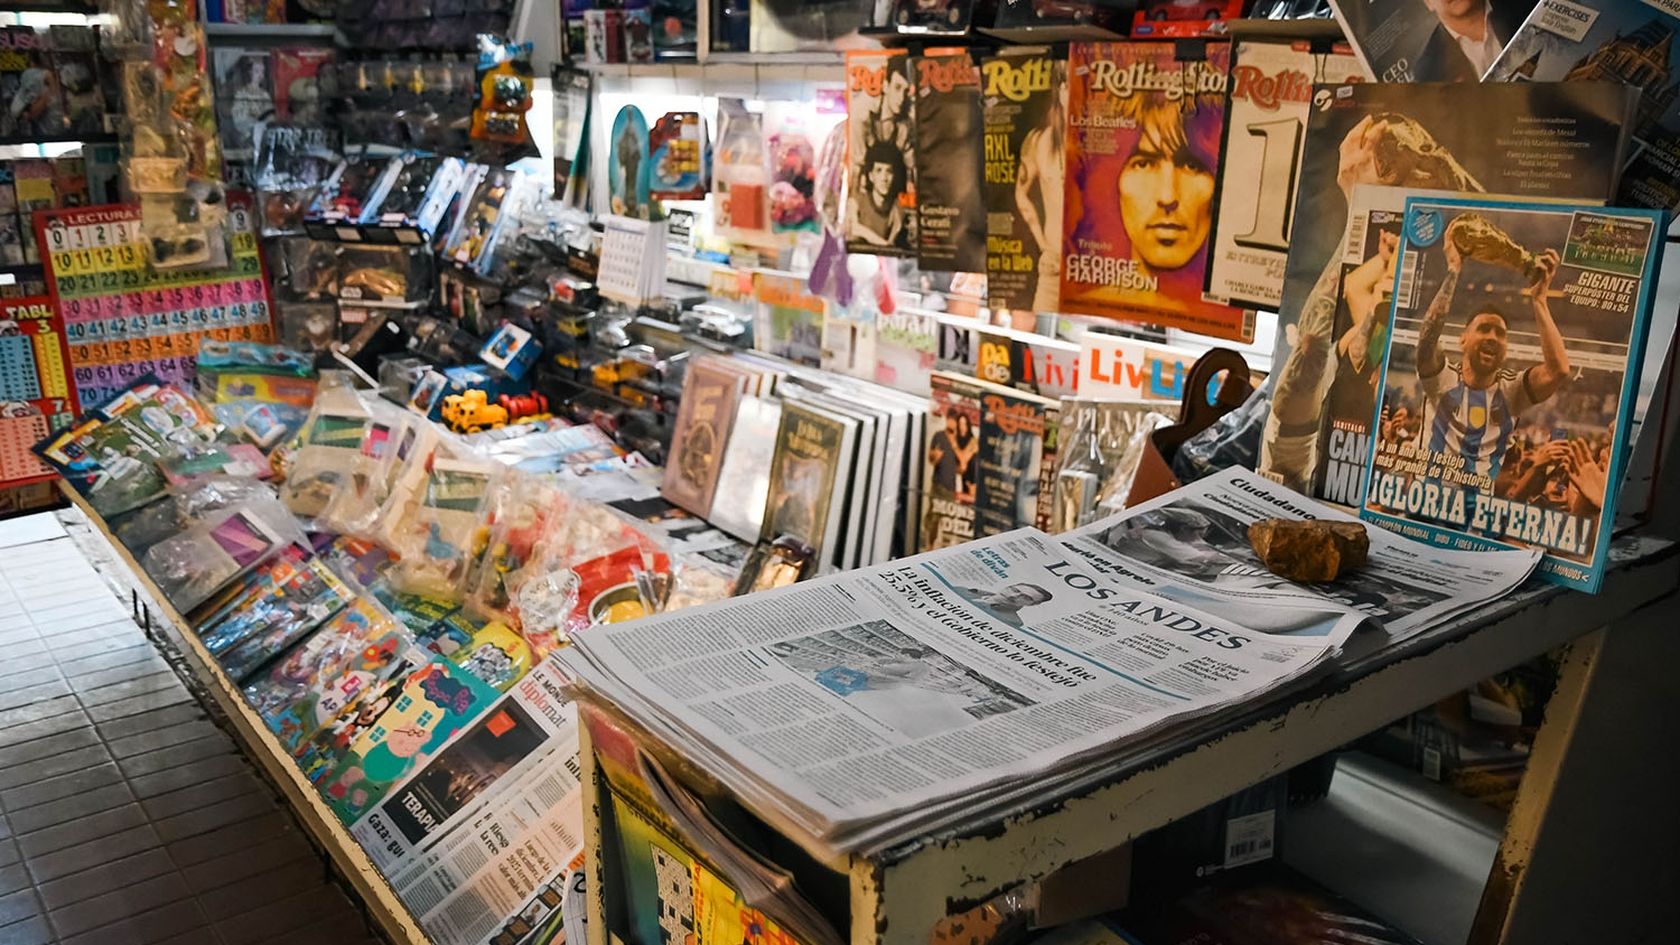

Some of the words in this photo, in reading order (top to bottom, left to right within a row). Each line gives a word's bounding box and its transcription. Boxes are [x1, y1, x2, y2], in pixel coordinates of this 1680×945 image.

[1383, 58, 1408, 84] CEO
[1094, 116, 1137, 129] Beatles
[985, 134, 1014, 161] AXL
[985, 162, 1016, 184] ROSE
[68, 210, 133, 224] LECTURA
[53, 230, 62, 244] 0
[75, 229, 83, 241] 1
[95, 226, 105, 240] 2
[118, 224, 126, 237] 3
[55, 254, 71, 268] 10
[75, 253, 91, 266] 11
[96, 250, 113, 264] 12
[118, 246, 134, 262] 13
[1066, 254, 1139, 272] GEORGE
[58, 277, 76, 291] 20
[81, 275, 96, 289] 21
[101, 272, 117, 286] 22
[122, 270, 139, 284] 23
[1066, 268, 1159, 292] HARRISON
[1578, 272, 1637, 294] GIGANTE
[1616, 293, 1630, 303] DEL
[69, 323, 84, 337] 40
[90, 321, 105, 335] 41
[112, 319, 126, 333] 42
[133, 316, 148, 330] 43
[153, 313, 168, 327] 44
[173, 312, 188, 325] 45
[192, 309, 208, 322] 46
[211, 307, 225, 319] 47
[232, 304, 247, 318] 48
[251, 302, 266, 316] 49
[73, 346, 88, 359] 50
[94, 344, 109, 357] 51
[76, 367, 93, 381] 60
[97, 366, 113, 380] 61
[119, 363, 135, 377] 62
[140, 361, 156, 375] 63
[160, 358, 176, 373] 64
[181, 355, 197, 369] 65
[81, 388, 97, 402] 70
[1379, 439, 1385, 451] A
[1386, 443, 1398, 455] un
[1416, 448, 1432, 461] del
[1433, 450, 1465, 469] festejo
[1376, 455, 1393, 468] más
[1395, 458, 1427, 476] grande
[1429, 465, 1441, 478] de
[1442, 467, 1455, 481] la
[1454, 469, 1492, 490] historia
[1371, 470, 1466, 524] ¡GLORIA
[1472, 494, 1591, 555] ETERNA!
[970, 549, 984, 559] de
[981, 546, 1010, 568] Letras
[1043, 559, 1117, 599] LOS
[1110, 600, 1251, 649] ANDES
[898, 566, 918, 579] La
[914, 579, 974, 621] inflación
[971, 620, 993, 632] de
[990, 631, 1069, 667] diciembre
[1067, 666, 1097, 681] fue
[926, 608, 947, 619] el
[941, 618, 1008, 654] Gobierno
[1006, 651, 1025, 662] lo
[1023, 660, 1082, 688] festejó
[532, 670, 545, 681] LE
[368, 813, 392, 843] Gaza:
